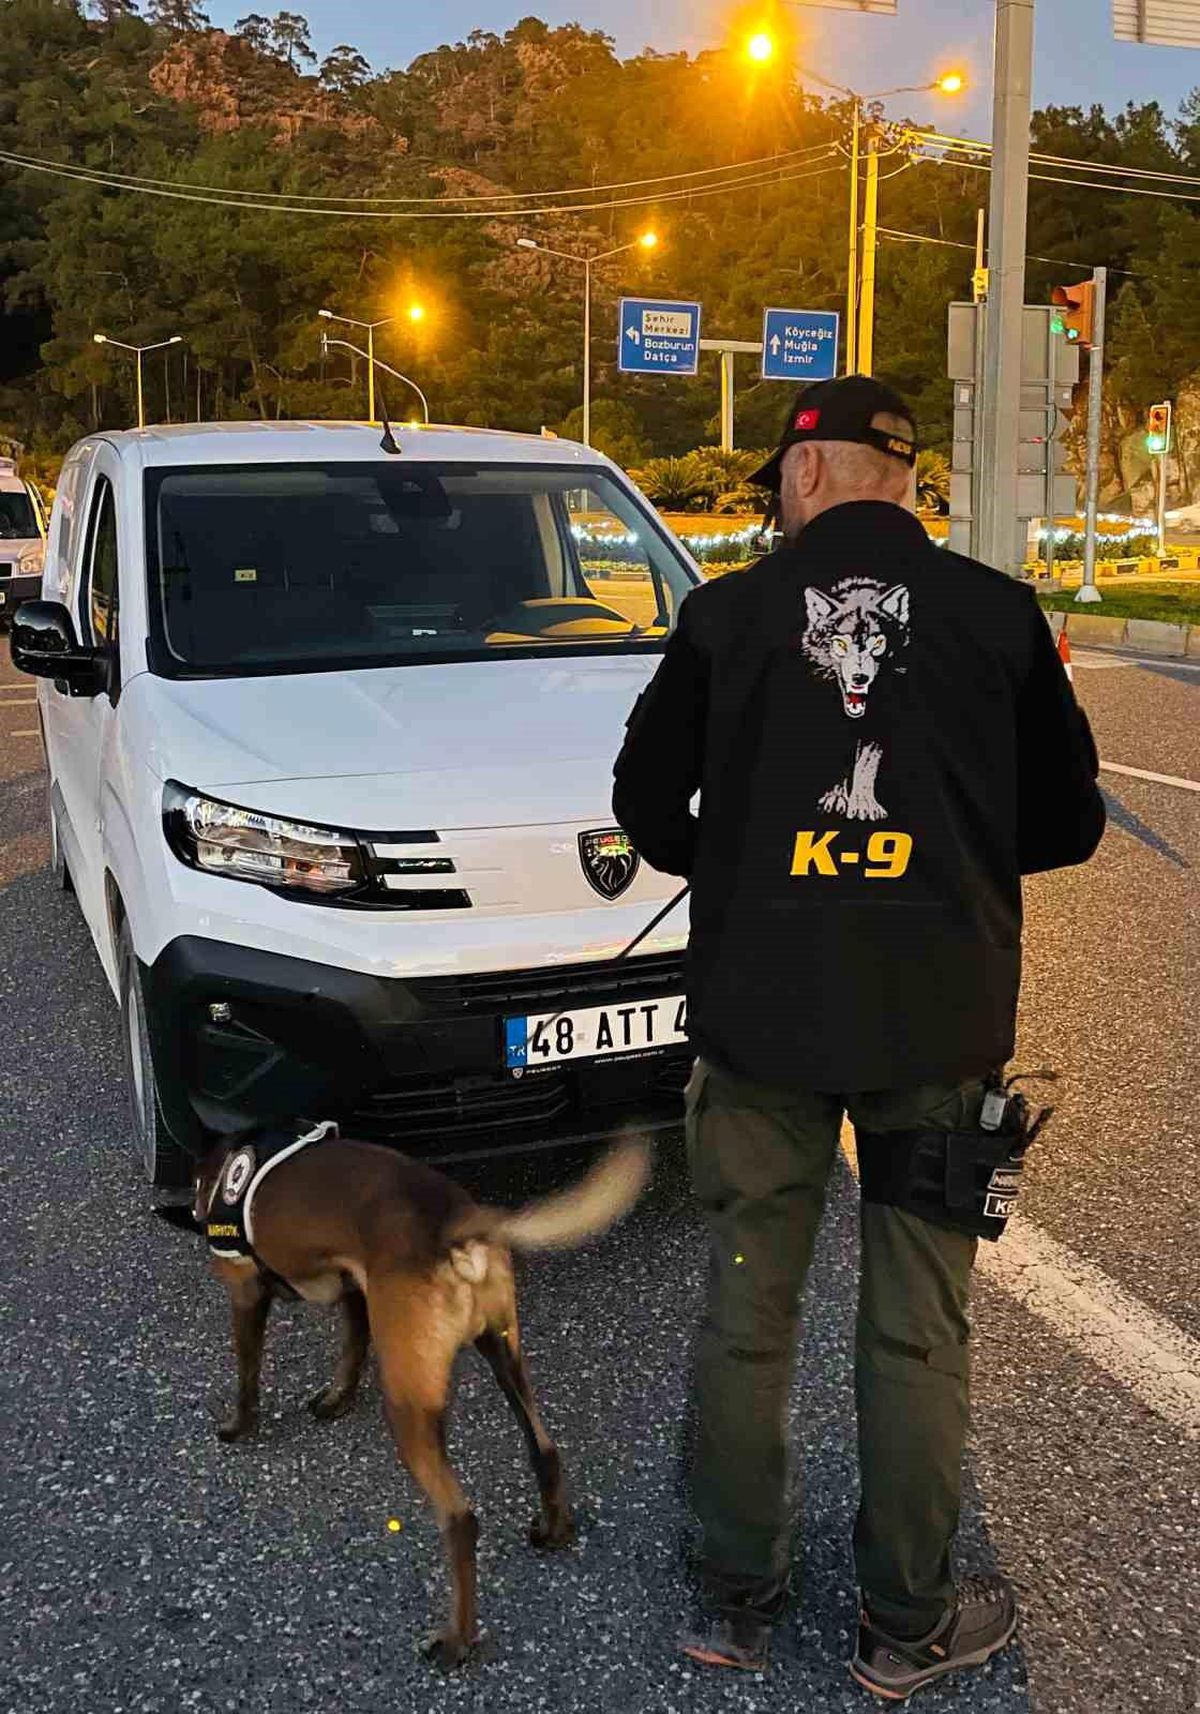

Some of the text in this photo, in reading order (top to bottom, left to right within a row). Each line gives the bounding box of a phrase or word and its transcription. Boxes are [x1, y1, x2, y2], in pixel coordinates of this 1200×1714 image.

[645, 324, 689, 335] Merkezi
[785, 326, 833, 340] Köyceğiz
[644, 338, 694, 350] Bozburun
[785, 340, 818, 352] Muğla
[644, 351, 677, 363] Datça
[789, 830, 913, 878] K-9
[532, 1017, 574, 1057] 48
[596, 1004, 659, 1049] ATT
